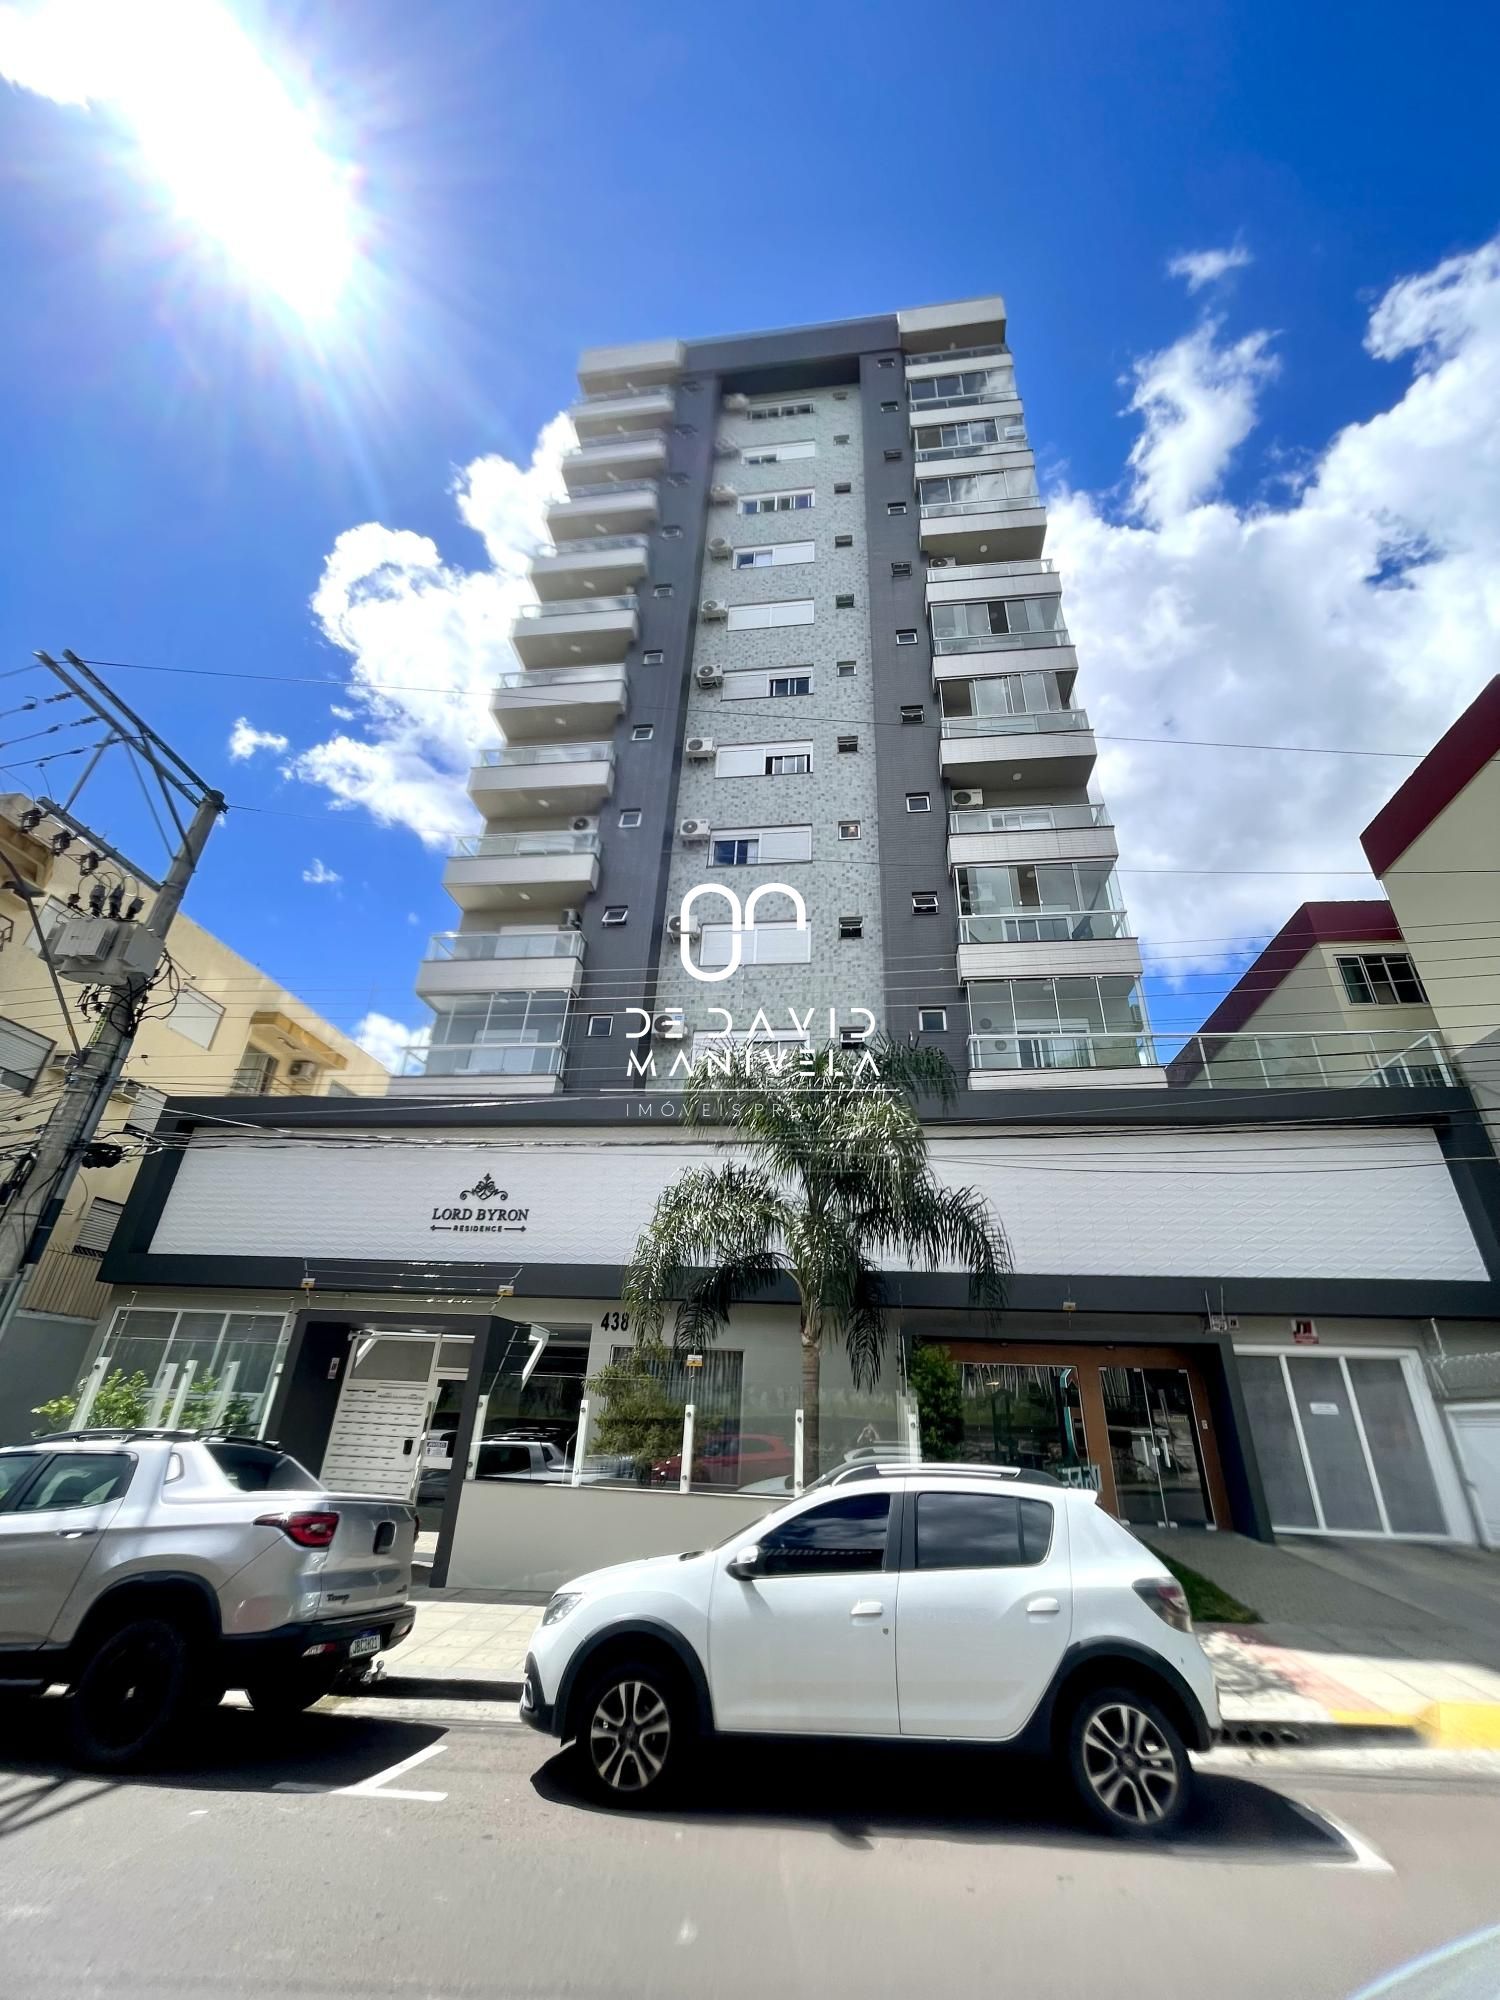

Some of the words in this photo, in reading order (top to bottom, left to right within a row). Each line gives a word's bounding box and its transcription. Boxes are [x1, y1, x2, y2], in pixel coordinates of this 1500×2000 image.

[431, 1208, 473, 1221] LORD
[475, 1208, 530, 1221] BYRON
[453, 1225, 503, 1233] RESIDENCE
[600, 1311, 630, 1332] 438
